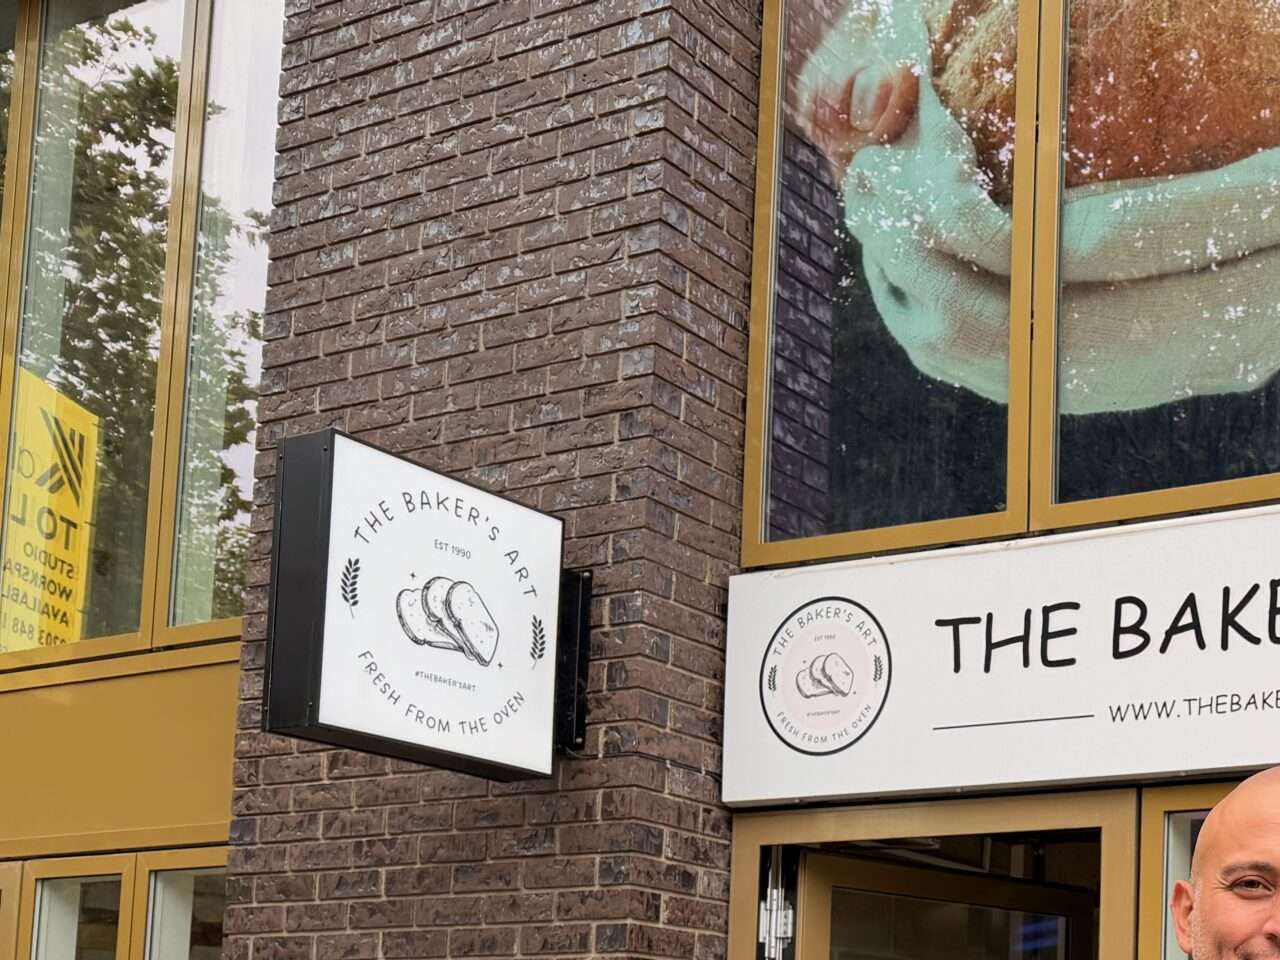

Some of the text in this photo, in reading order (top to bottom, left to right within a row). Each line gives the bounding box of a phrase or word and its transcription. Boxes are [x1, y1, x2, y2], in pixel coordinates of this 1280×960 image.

[354, 490, 537, 598] THE BAKER'S ART
[434, 538, 472, 559] EST 1990
[773, 606, 878, 656] THE BAKER'S ART
[935, 601, 1081, 674] THE
[357, 650, 525, 735] FRESH FROM THE OVEN
[777, 711, 799, 736] FRESH
[801, 733, 828, 744] FROM
[832, 728, 849, 741] THE
[852, 704, 872, 728] OVEN
